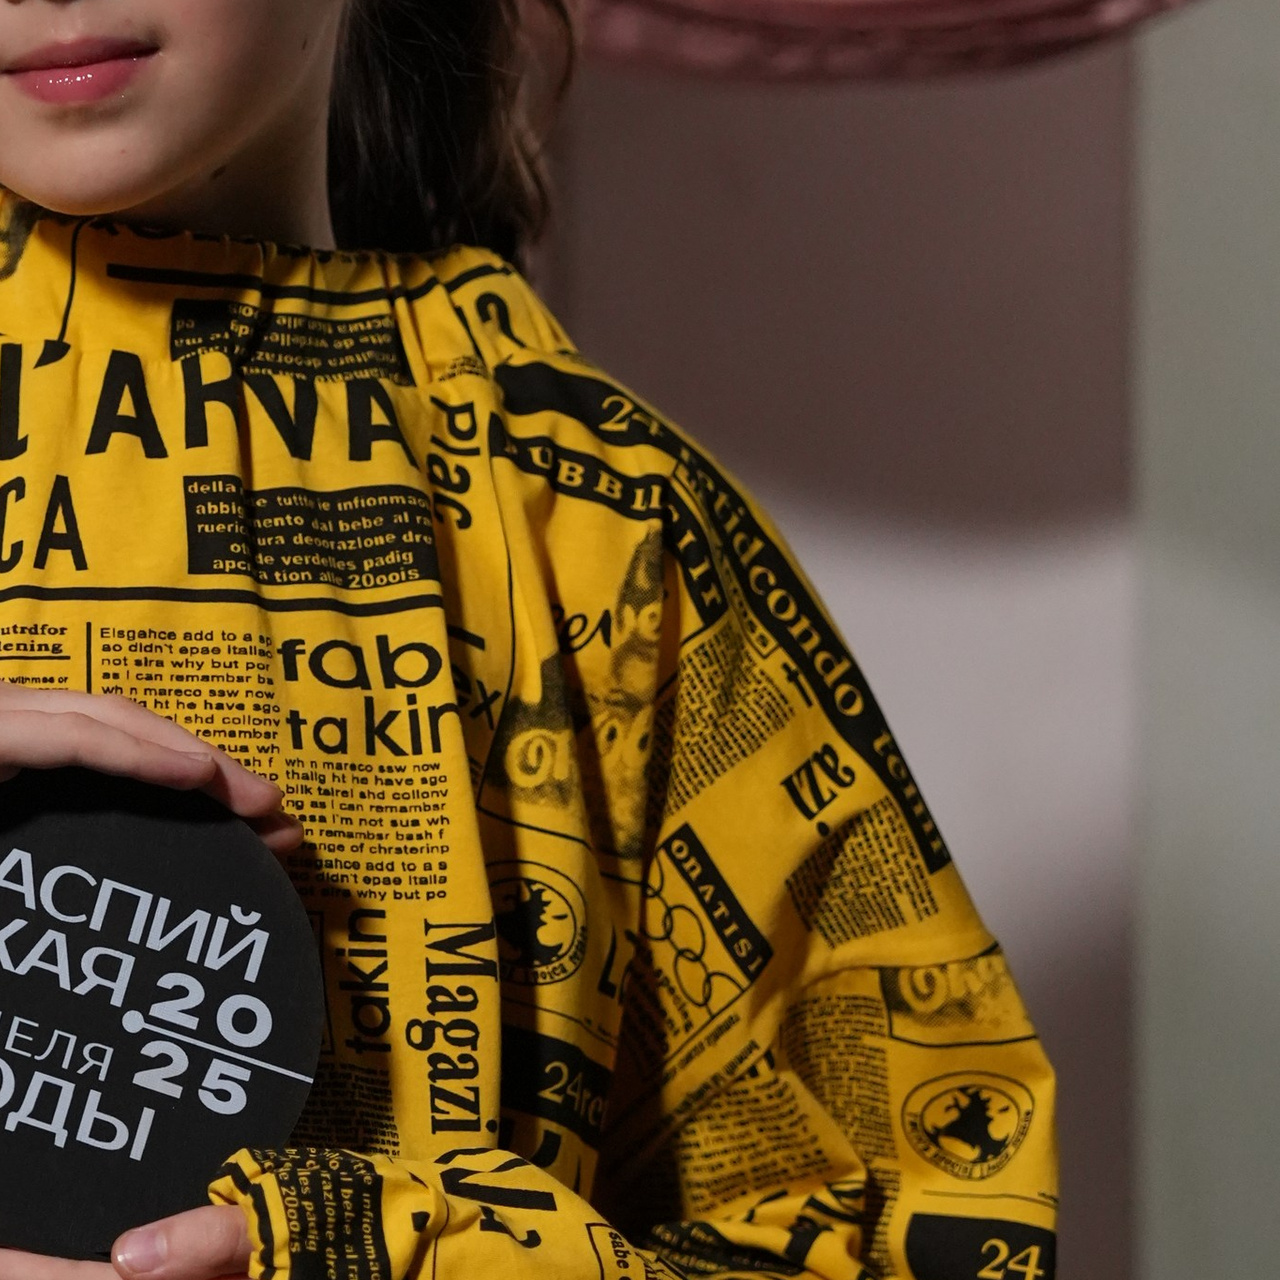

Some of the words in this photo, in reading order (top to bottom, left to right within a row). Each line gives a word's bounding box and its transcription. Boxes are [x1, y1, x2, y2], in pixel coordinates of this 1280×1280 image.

[183, 630, 214, 642] add
[221, 630, 237, 642] to
[101, 656, 128, 667] not
[170, 658, 204, 671] why
[211, 659, 239, 669] but
[245, 690, 275, 700] now
[203, 700, 246, 711] have
[412, 762, 441, 773] now
[374, 775, 414, 786] have
[358, 816, 384, 827] not
[350, 842, 365, 854] of
[365, 861, 395, 872] add
[356, 889, 387, 901] why
[393, 890, 421, 900] but
[148, 971, 273, 1049] 20
[405, 917, 500, 1135] Magazi
[132, 1040, 252, 1116] 25
